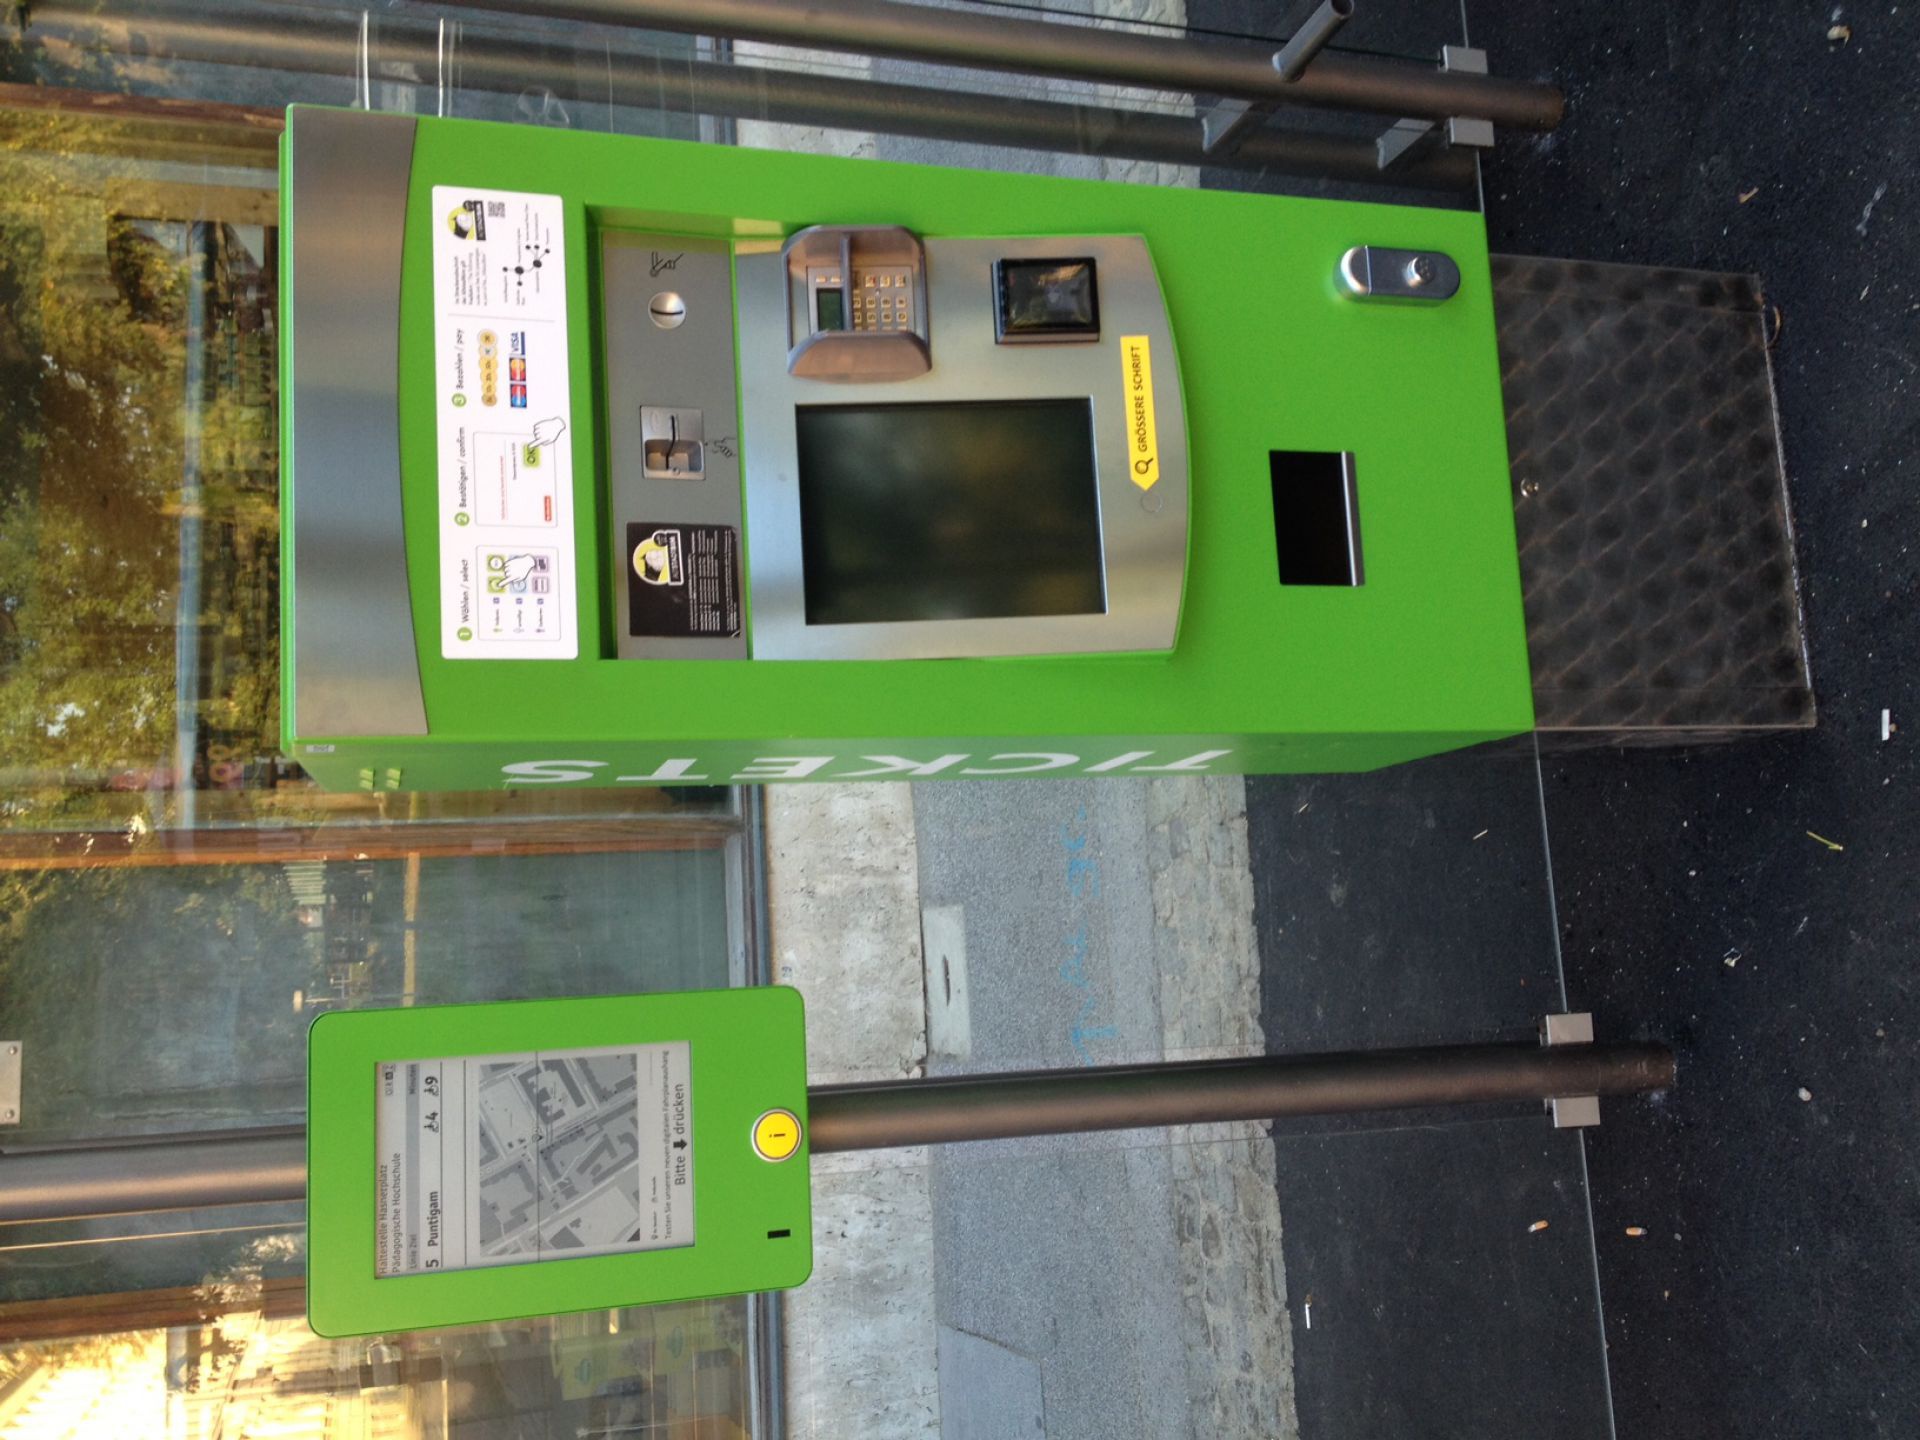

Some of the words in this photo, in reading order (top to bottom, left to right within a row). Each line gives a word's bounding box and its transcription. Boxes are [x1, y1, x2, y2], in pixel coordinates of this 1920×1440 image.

[456, 328, 466, 344] pay
[510, 332, 519, 352] VISA
[455, 352, 464, 388] Bezahlen
[1130, 345, 1143, 391] SCHRIFT
[1134, 395, 1148, 453] GRÖSSERE
[456, 426, 466, 457] confirm
[458, 466, 468, 508] Bestätigen
[460, 559, 469, 582] select
[460, 590, 470, 623] Wählen
[502, 750, 1234, 780] TICKETS
[408, 1064, 416, 1095] Minuten
[425, 1076, 438, 1085] 9
[661, 1050, 671, 1112] Fahrplanaushang
[426, 1112, 438, 1121] 4
[673, 1083, 685, 1135] drücken
[662, 1112, 672, 1144] digitalen
[391, 1152, 401, 1206] Hochschule
[664, 1170, 672, 1200] unseren
[674, 1155, 686, 1186] Bitte
[379, 1164, 390, 1220] Hasnerplatz
[664, 1201, 672, 1213] Sie
[427, 1191, 440, 1247] Puntigam
[664, 1214, 672, 1239] Testen
[379, 1222, 388, 1274] Haltestelle
[391, 1208, 402, 1273] Pädagogische
[409, 1234, 417, 1248] Ziel
[409, 1250, 417, 1269] Linie
[426, 1259, 439, 1268] 5
